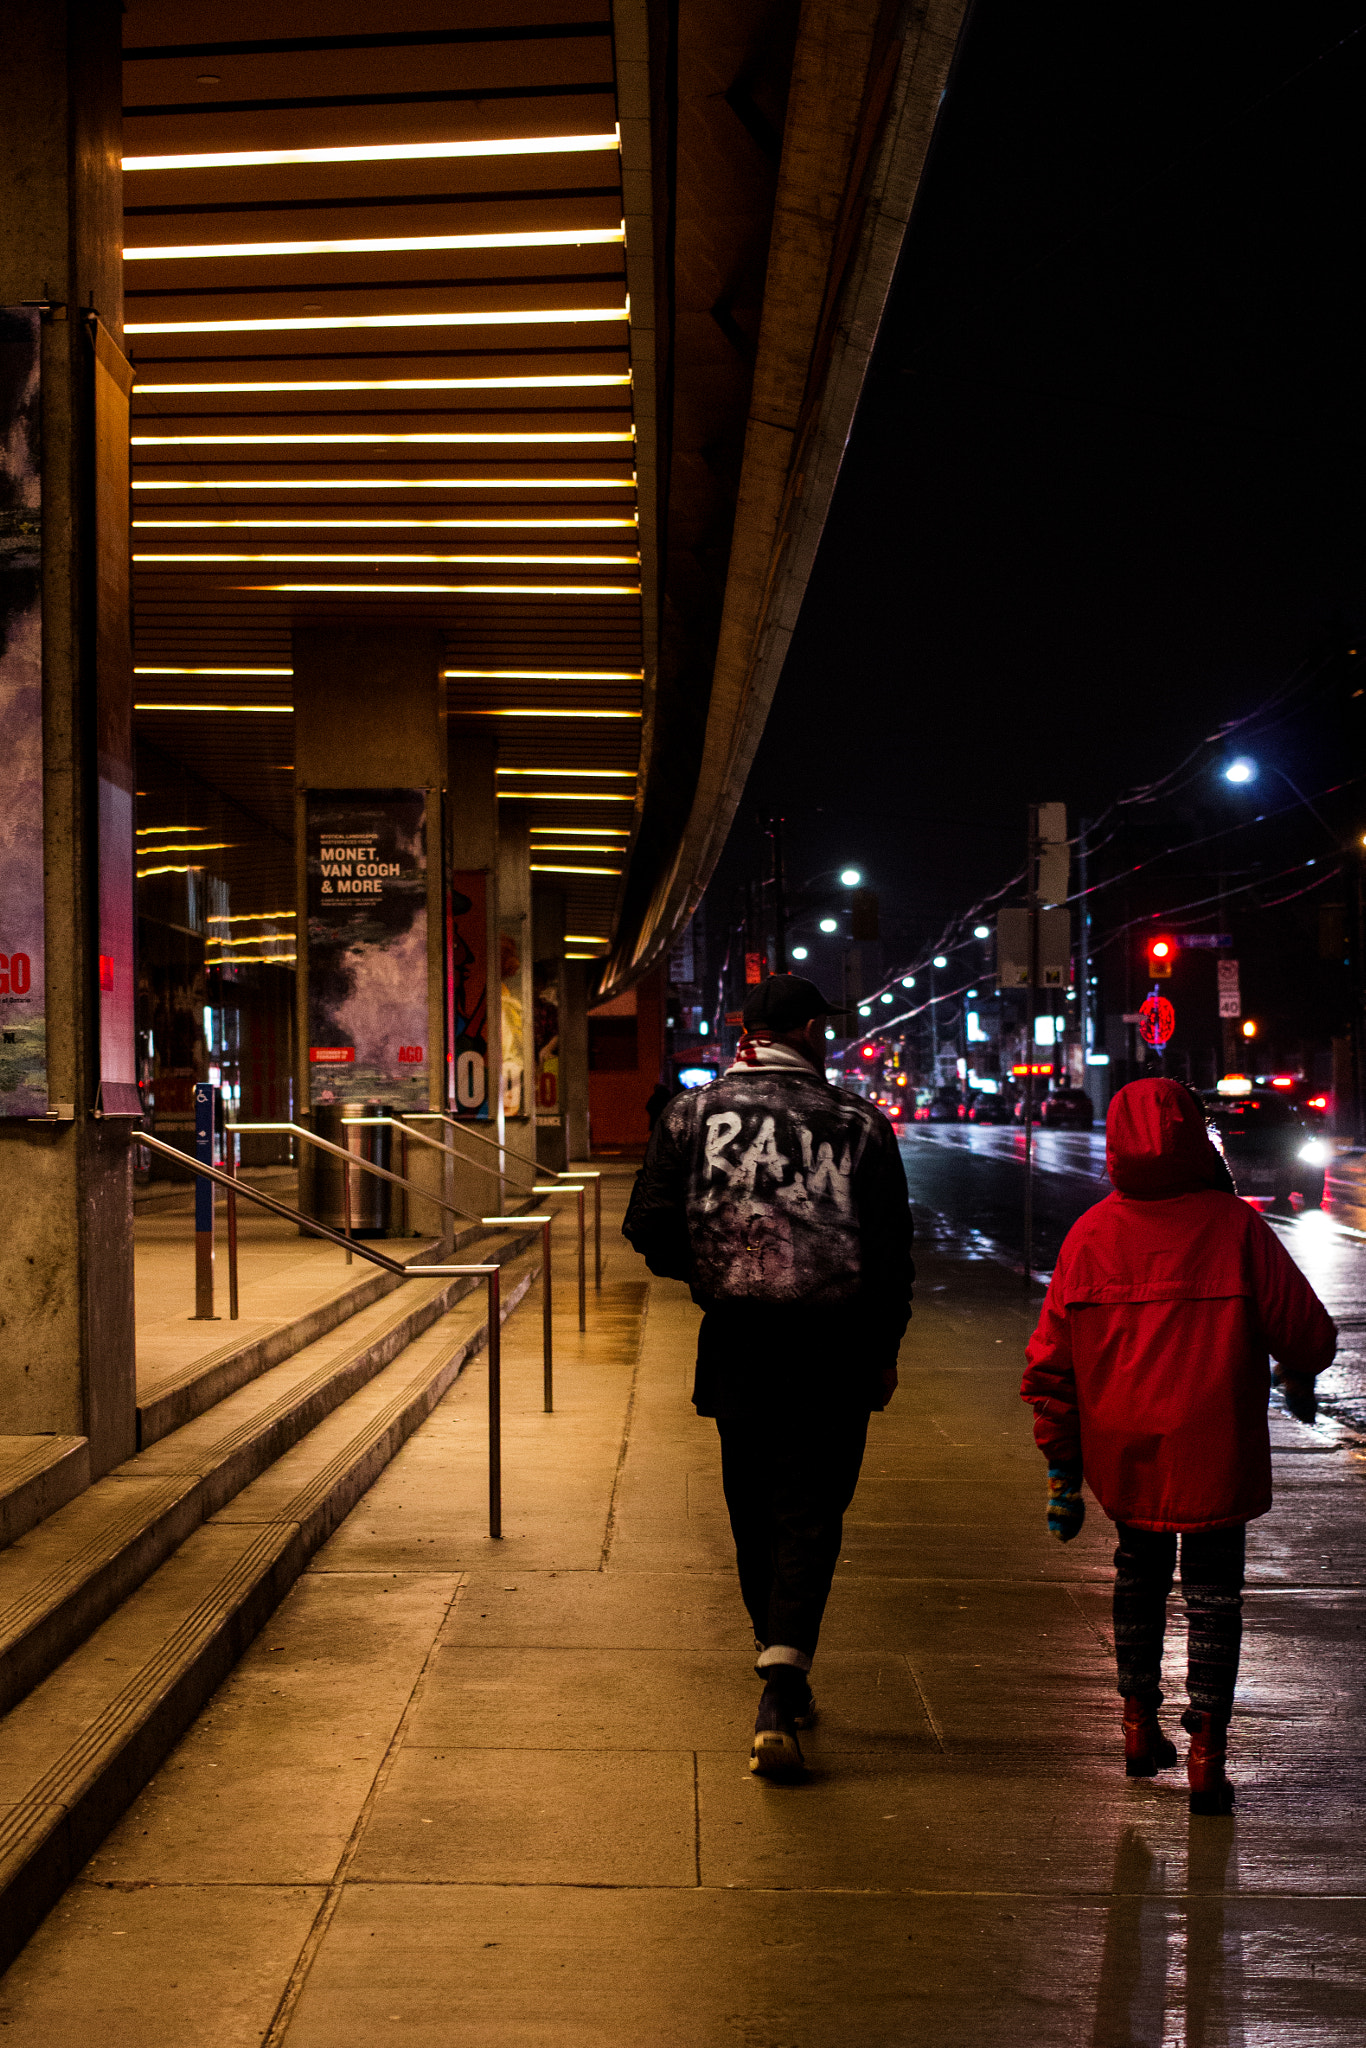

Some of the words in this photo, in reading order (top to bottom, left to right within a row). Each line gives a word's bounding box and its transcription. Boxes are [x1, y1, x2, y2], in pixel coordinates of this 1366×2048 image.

[320, 847, 380, 862] MONET,
[320, 863, 353, 877] VAN
[356, 863, 401, 877] GOGH
[321, 880, 334, 894] &
[337, 880, 383, 894] MORE
[398, 1045, 423, 1063] AGO
[702, 1110, 856, 1218] RAW
